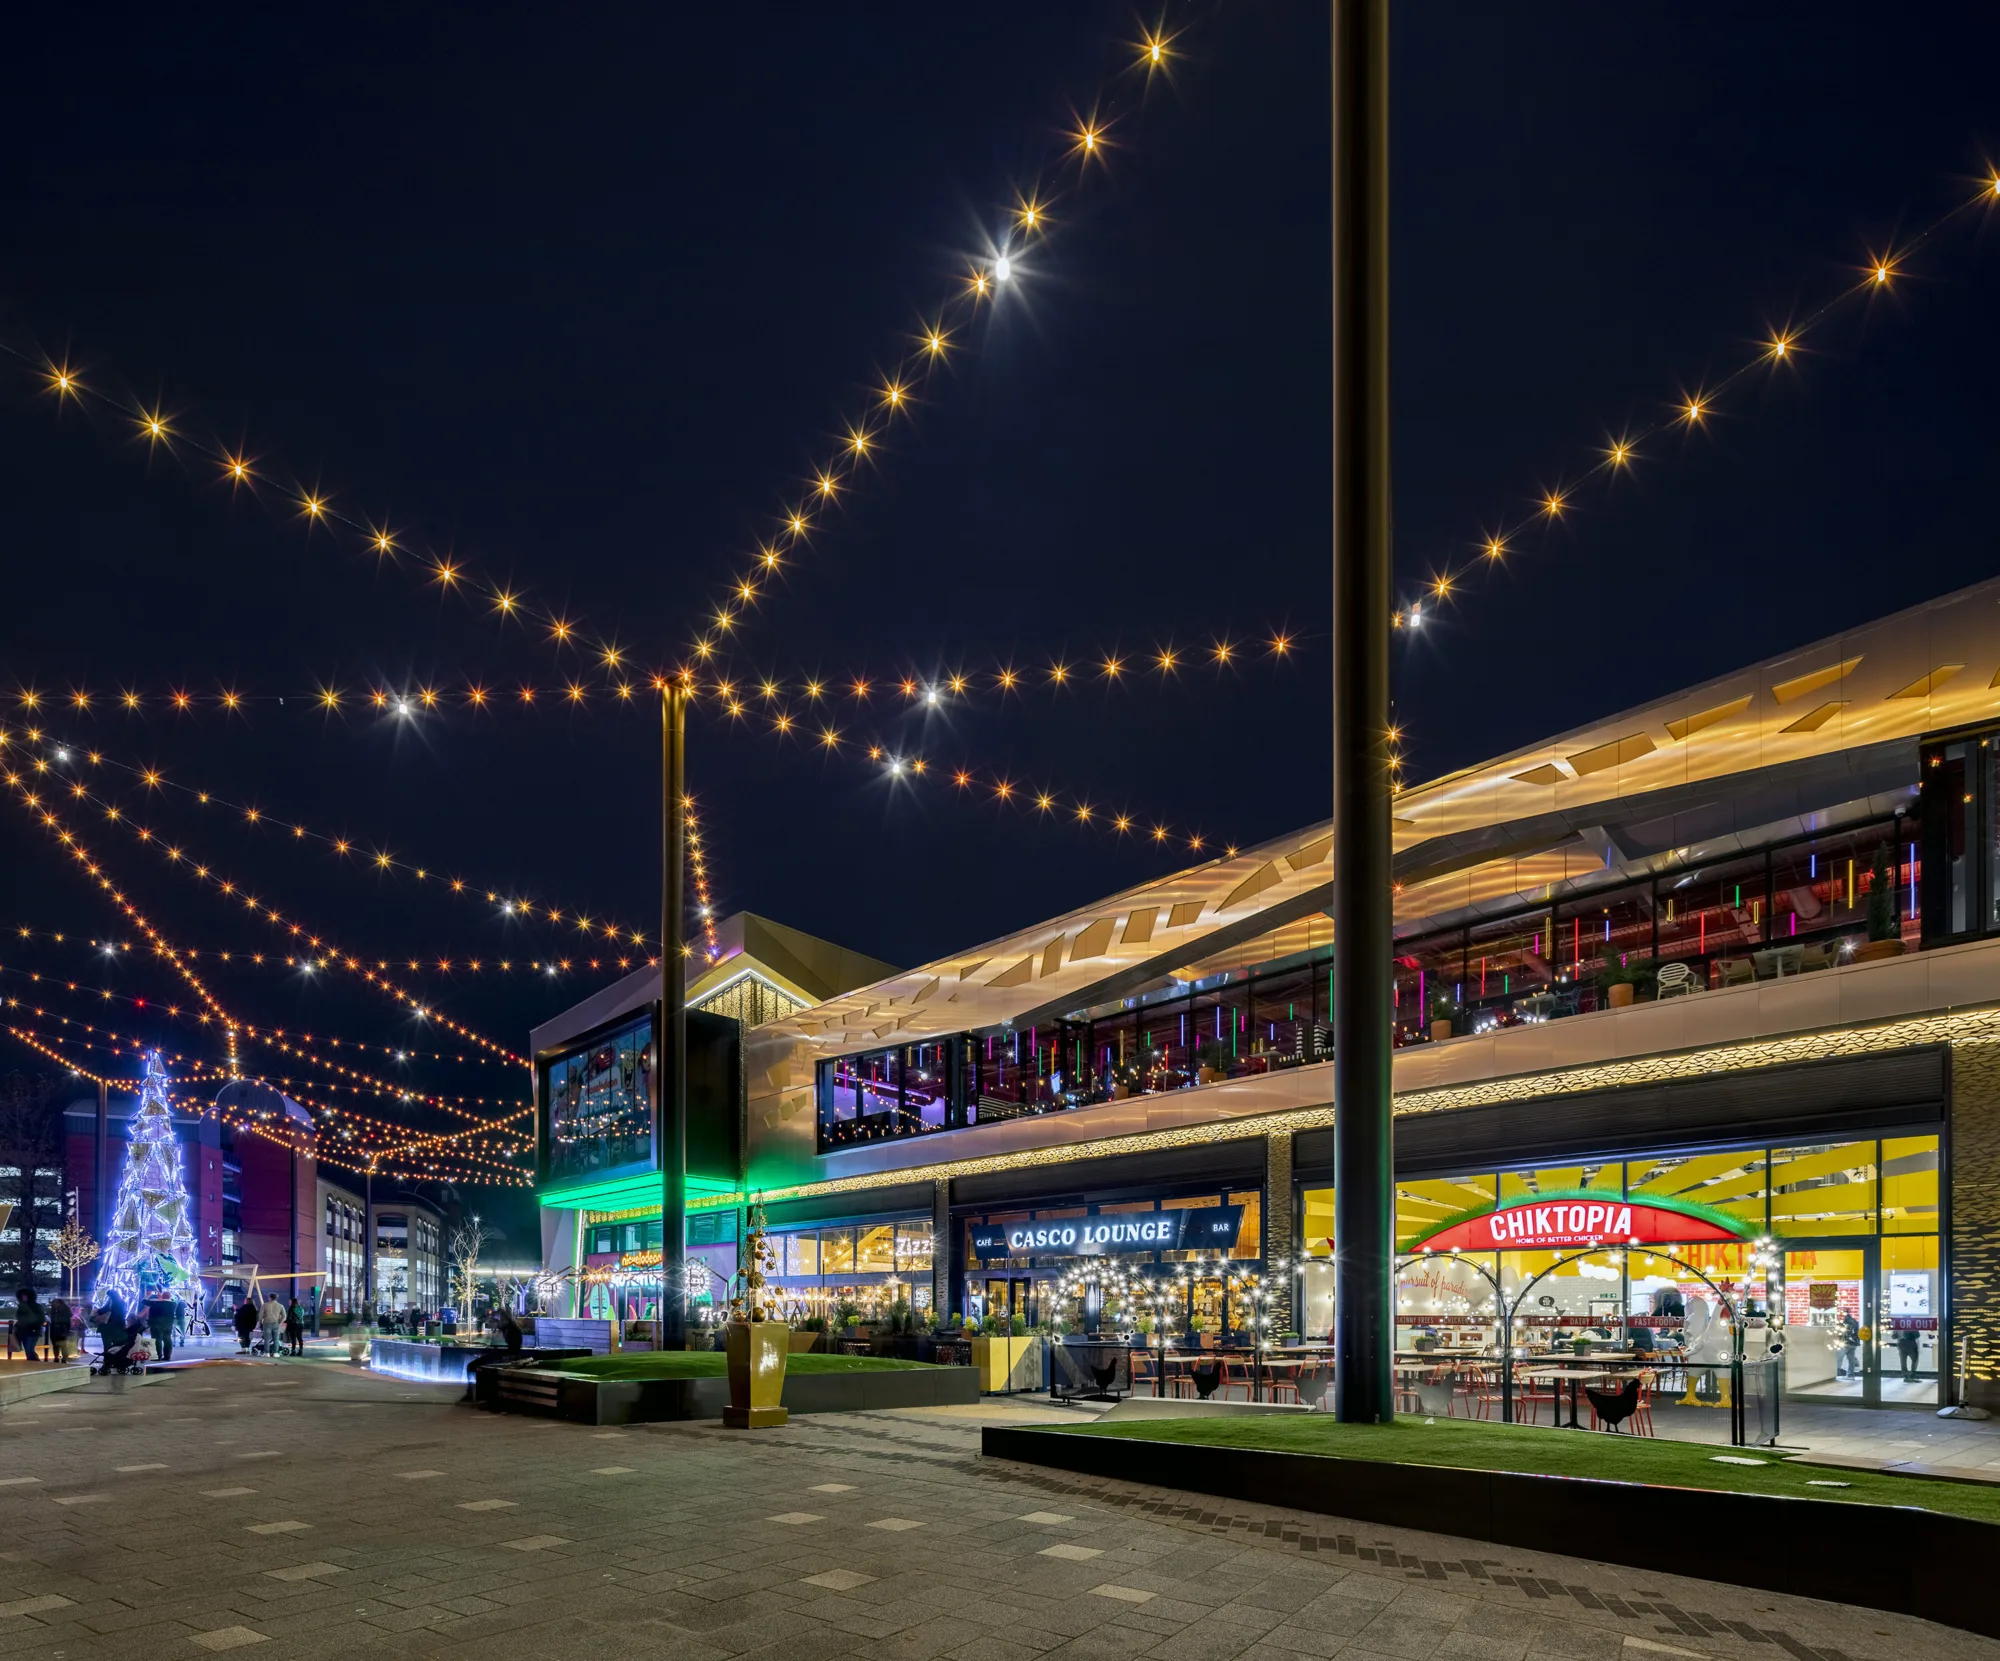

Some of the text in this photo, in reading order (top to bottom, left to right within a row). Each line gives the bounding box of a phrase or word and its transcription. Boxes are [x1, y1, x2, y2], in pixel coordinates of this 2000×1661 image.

[1212, 1223, 1230, 1232] BAR
[1489, 1205, 1632, 1241] CHIKTOPIA
[1011, 1221, 1171, 1248] CASCO LOUNGE
[1573, 1233, 1604, 1242] CHICKEN
[976, 1237, 992, 1246] CAFÉ
[1398, 1269, 1429, 1301] pursuit
[1430, 1269, 1441, 1299] of
[1396, 1316, 1434, 1324] SKINNY FRIES
[1570, 1317, 1590, 1326] DAIRY
[1634, 1317, 1674, 1326] FAST-FOOD
[1900, 1319, 1912, 1328] OR
[1916, 1319, 1934, 1328] OUT
